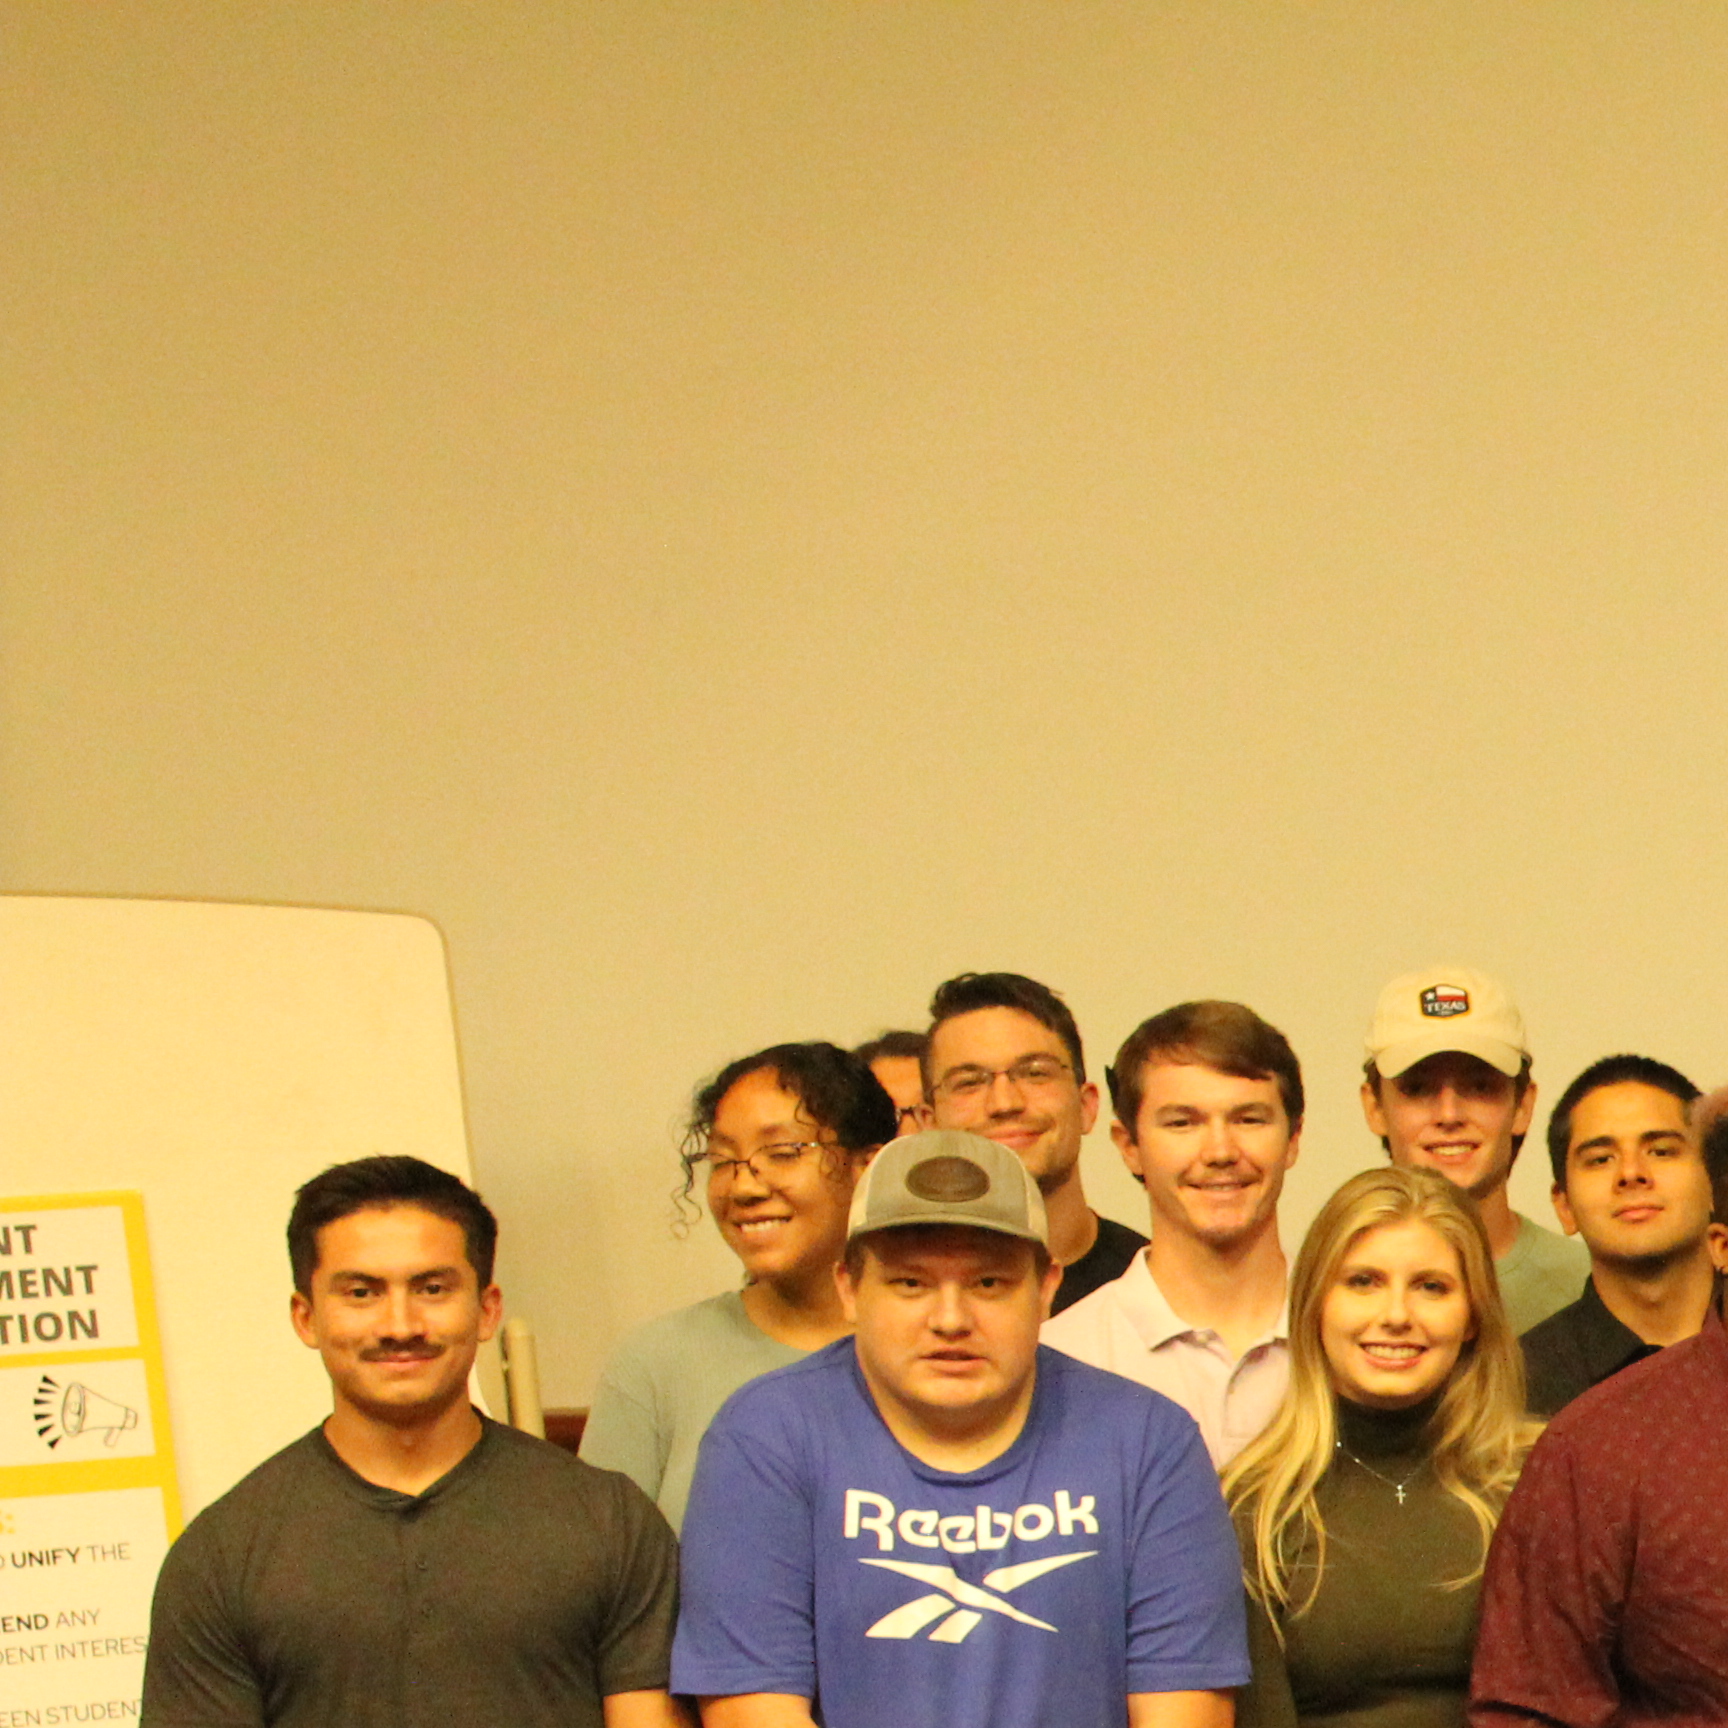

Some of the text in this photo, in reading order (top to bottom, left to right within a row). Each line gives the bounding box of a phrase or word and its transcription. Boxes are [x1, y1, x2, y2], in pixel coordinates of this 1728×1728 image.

[1424, 1000, 1466, 1012] TEXAS
[843, 1489, 1099, 1553] Reebok
[11, 1546, 80, 1569] UNIFY
[86, 1541, 131, 1563] THE
[55, 1608, 101, 1628] ANY
[0, 1644, 48, 1666] ENT
